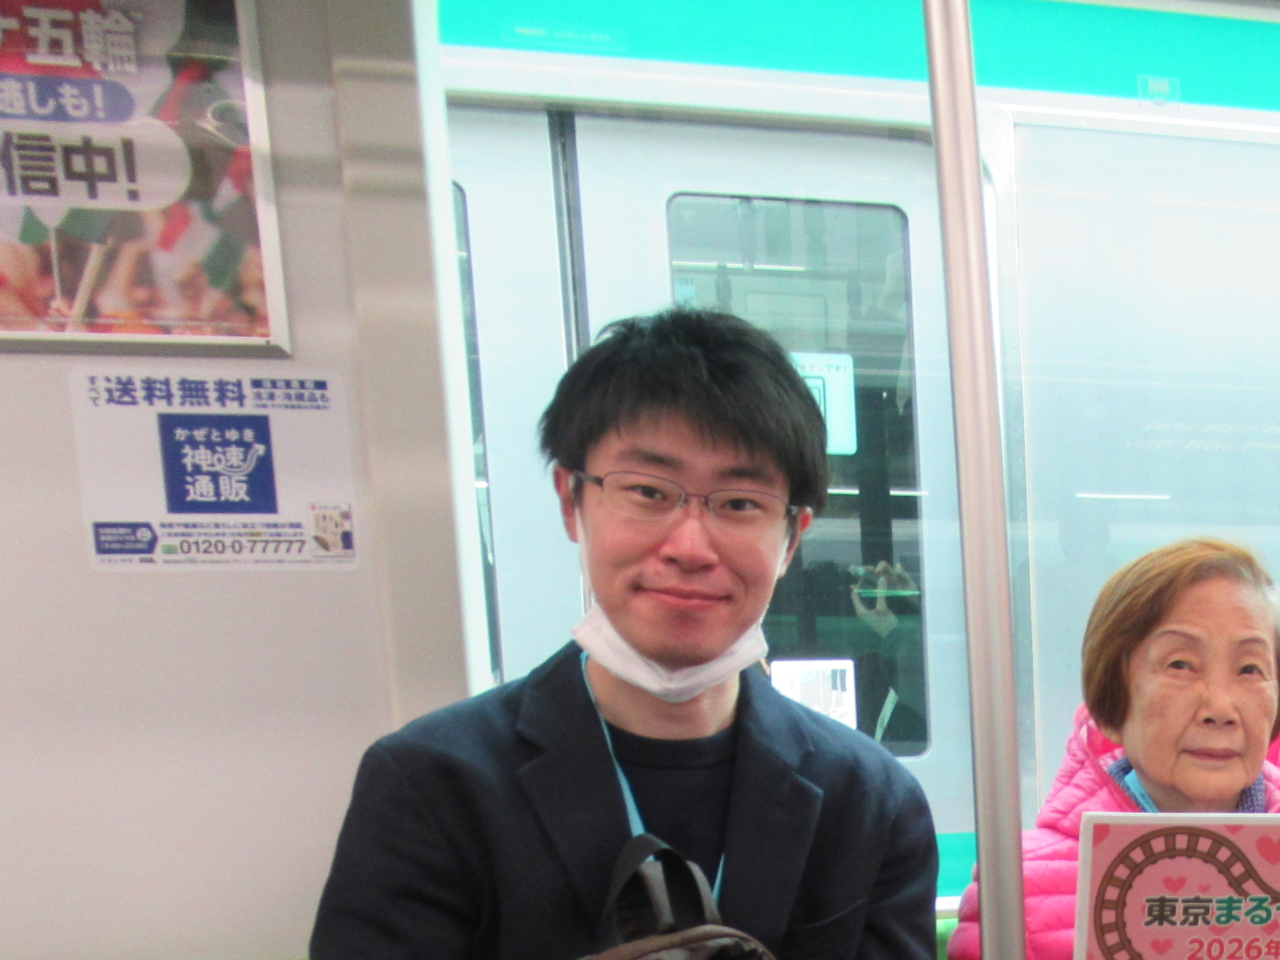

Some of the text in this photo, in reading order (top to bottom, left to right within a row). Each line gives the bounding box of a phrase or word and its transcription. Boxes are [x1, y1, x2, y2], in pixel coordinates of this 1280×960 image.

[104, 375, 246, 408] 送料無料
[174, 427, 256, 442] かぜとゆき
[185, 475, 251, 502] 通販
